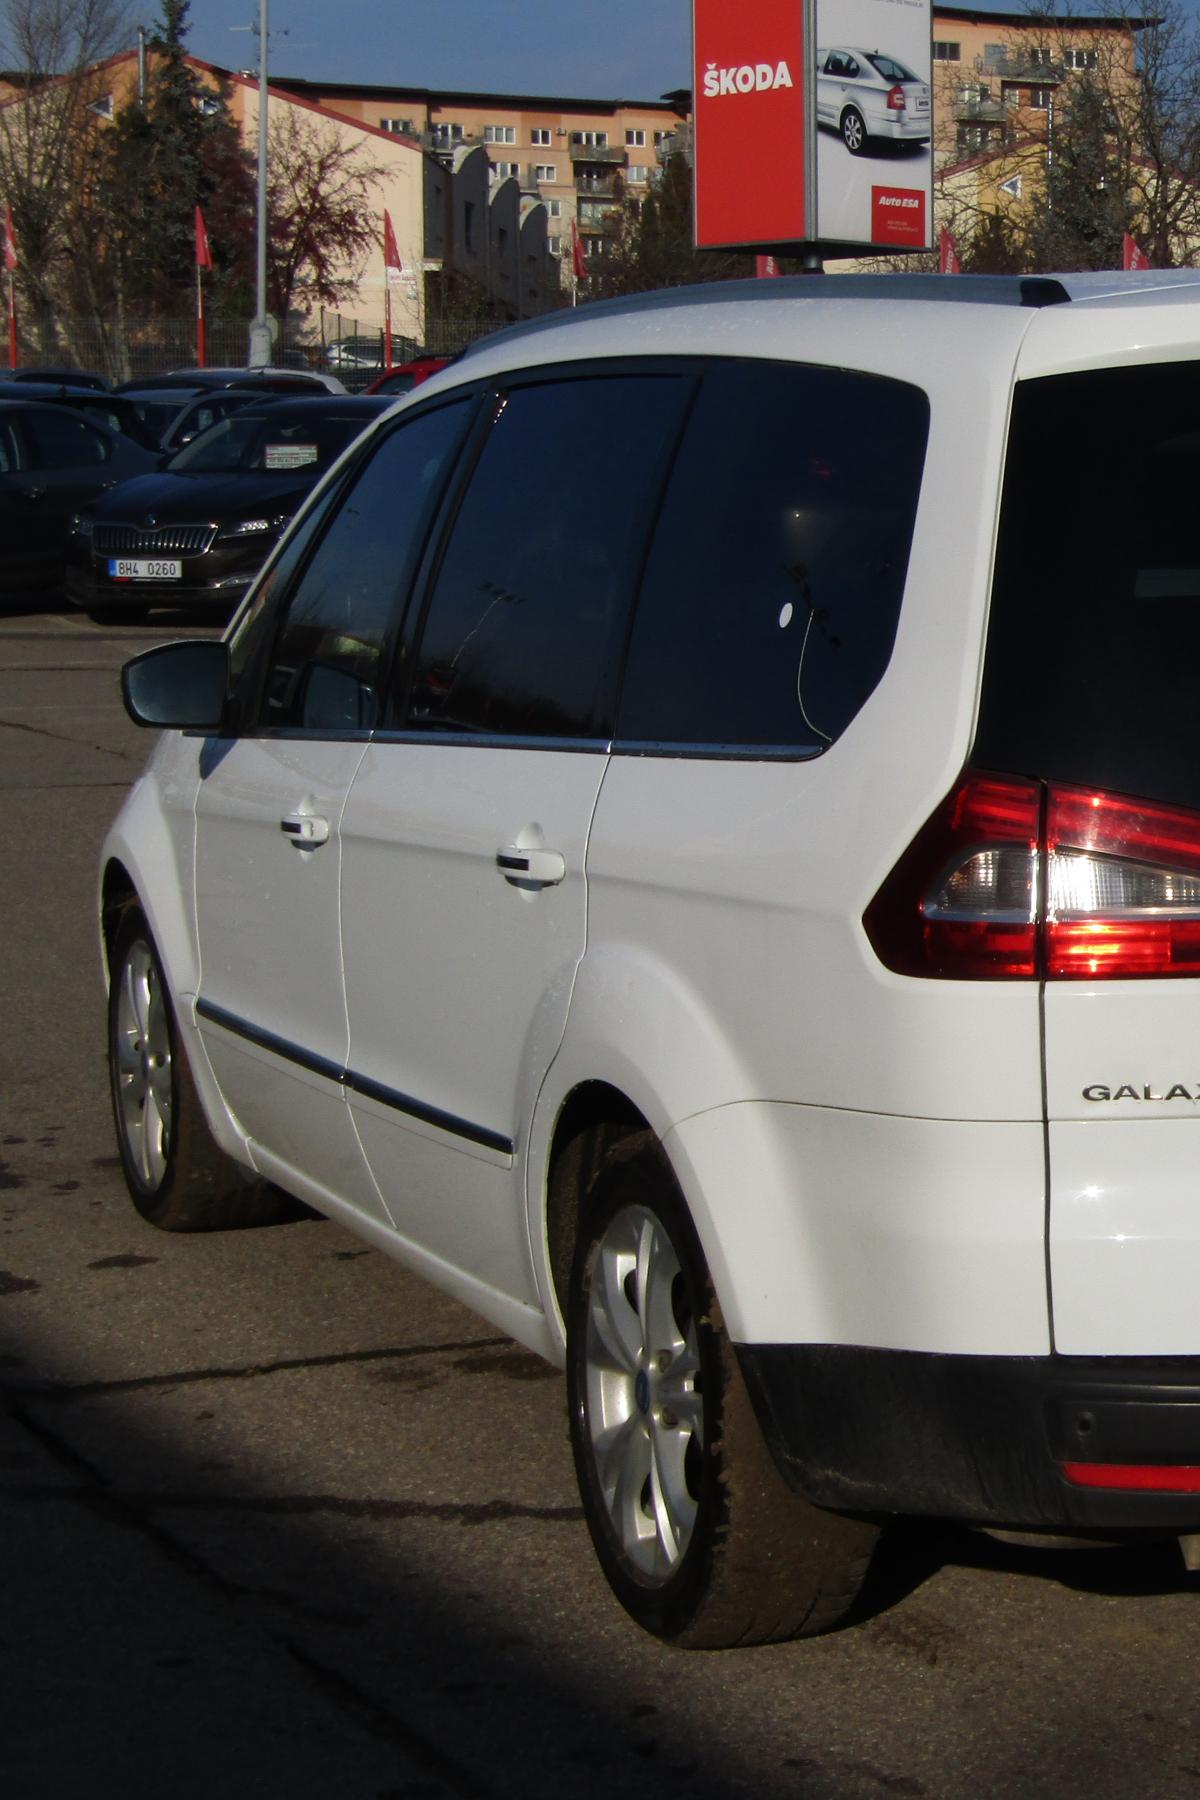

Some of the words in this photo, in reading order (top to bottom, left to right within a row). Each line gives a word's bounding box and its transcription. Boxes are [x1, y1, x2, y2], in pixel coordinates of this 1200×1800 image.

[703, 61, 793, 97] ŠKODA
[902, 198, 919, 208] ESA
[119, 562, 139, 575] 8H4
[148, 563, 176, 575] 0260
